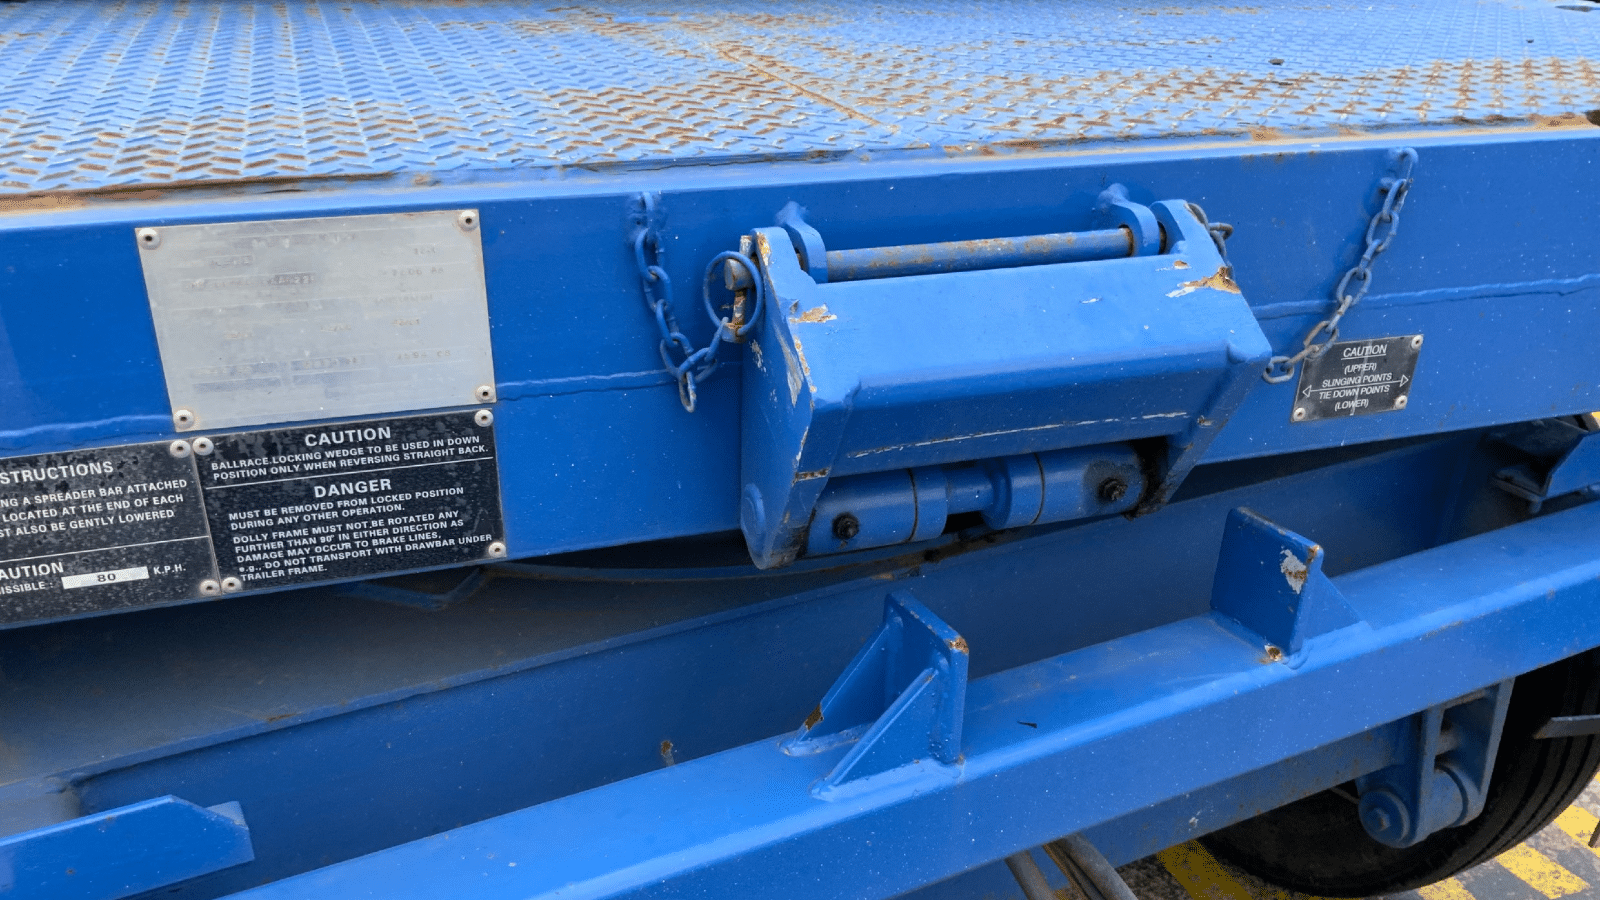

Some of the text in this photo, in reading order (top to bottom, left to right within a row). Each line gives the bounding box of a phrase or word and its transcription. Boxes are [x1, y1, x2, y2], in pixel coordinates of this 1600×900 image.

[1343, 344, 1387, 358] CAUTION
[1322, 373, 1392, 388] SLINGING POINTS
[1344, 363, 1377, 374] (UPPER)
[1319, 385, 1390, 399] TIE DOWN POINTS
[1335, 399, 1369, 411] (LOWER)
[272, 452, 322, 464] LOCKING
[325, 448, 364, 458] WEDGE
[367, 446, 382, 454] TO
[385, 444, 398, 452] BE
[402, 441, 430, 450] USED
[447, 436, 480, 446] DOWN
[305, 427, 391, 446] CAUTION
[0, 461, 114, 485] STRUCTIONS
[214, 445, 488, 480] POSITION ONLY WHEN REVERSING STRAIGHT BACK.
[23, 496, 31, 506] A
[34, 489, 96, 504] SPREADER
[99, 487, 123, 497] BAR
[127, 479, 187, 494] ATTACHED
[314, 479, 391, 498] DANGER
[3, 494, 184, 522] LOCATED AT THE END OF EACH
[229, 487, 464, 520] MUST BE REMOVED FROM LOCKED POSITION
[231, 504, 405, 530] DURING ANY OTHER OPERATION.
[15, 524, 47, 536] ALSO
[50, 522, 66, 531] BE
[69, 515, 115, 529] GENTLY
[118, 509, 175, 524] LOWERED
[233, 510, 458, 544] DOLLY FRAME MUST NOT BE ROTATED ANY
[235, 541, 284, 553] FURTHER
[287, 537, 317, 547] THAN
[338, 532, 350, 540] IN
[353, 528, 389, 539] EITHER
[392, 522, 447, 534] DIRECTION
[237, 551, 284, 563] DAMAGE
[287, 548, 310, 556] MAY
[314, 542, 352, 553] OCCUR
[355, 540, 369, 548] TO
[372, 536, 405, 546] BRAKE
[239, 534, 492, 573] e.g., DO NOT TRANSPORT WITH DRAWBAR UNDER
[0, 581, 46, 595] ISSIBLE
[97, 572, 116, 583] 80
[153, 564, 186, 575] K.P.H.
[241, 564, 327, 581] TRAILER FRAME.
